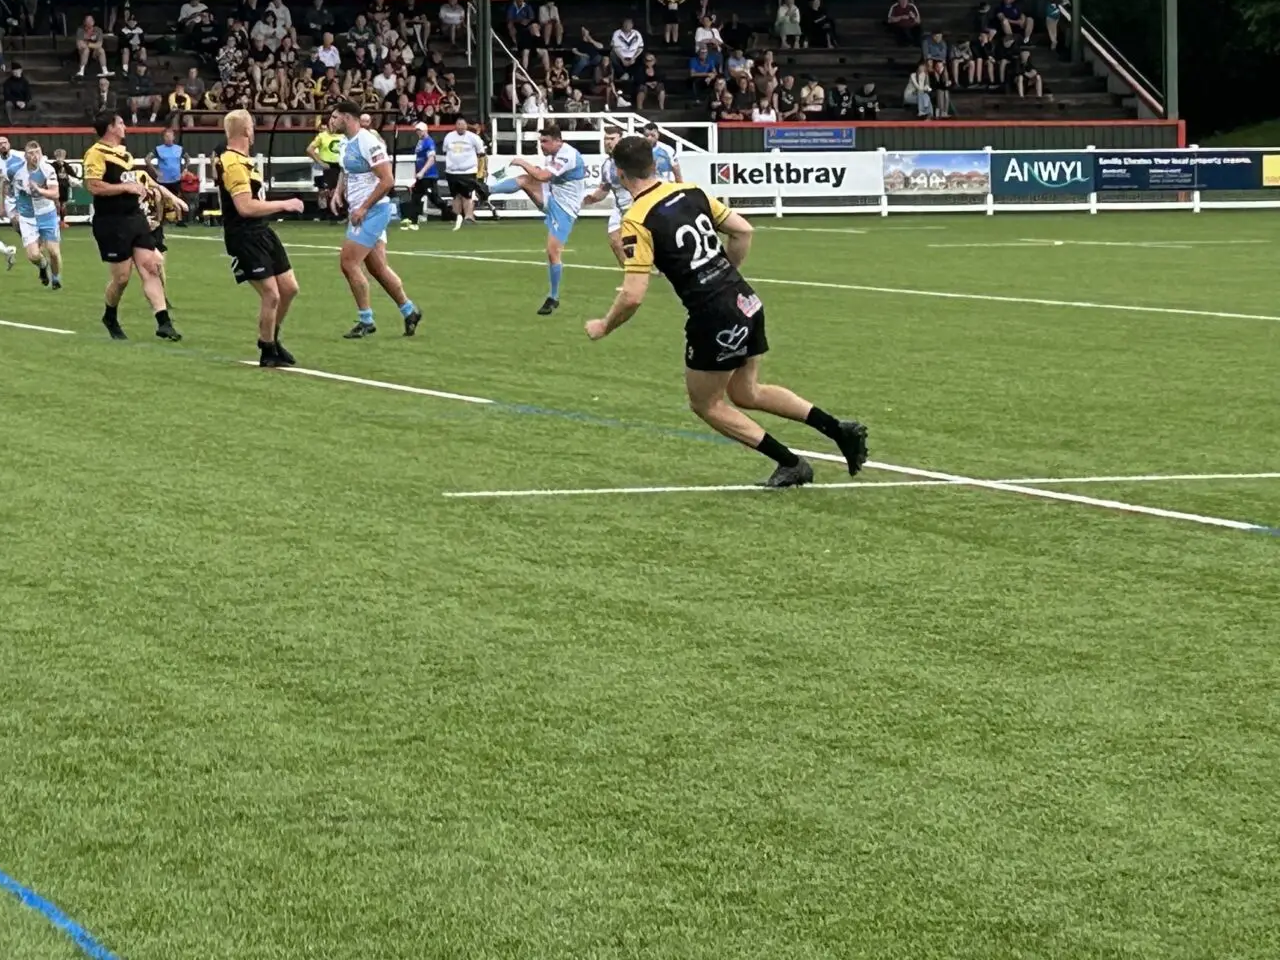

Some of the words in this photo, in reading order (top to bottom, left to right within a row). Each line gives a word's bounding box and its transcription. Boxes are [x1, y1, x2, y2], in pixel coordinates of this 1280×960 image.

[733, 162, 846, 188] keltbray
[1004, 158, 1088, 183] ANWYL
[675, 213, 721, 270] 28
